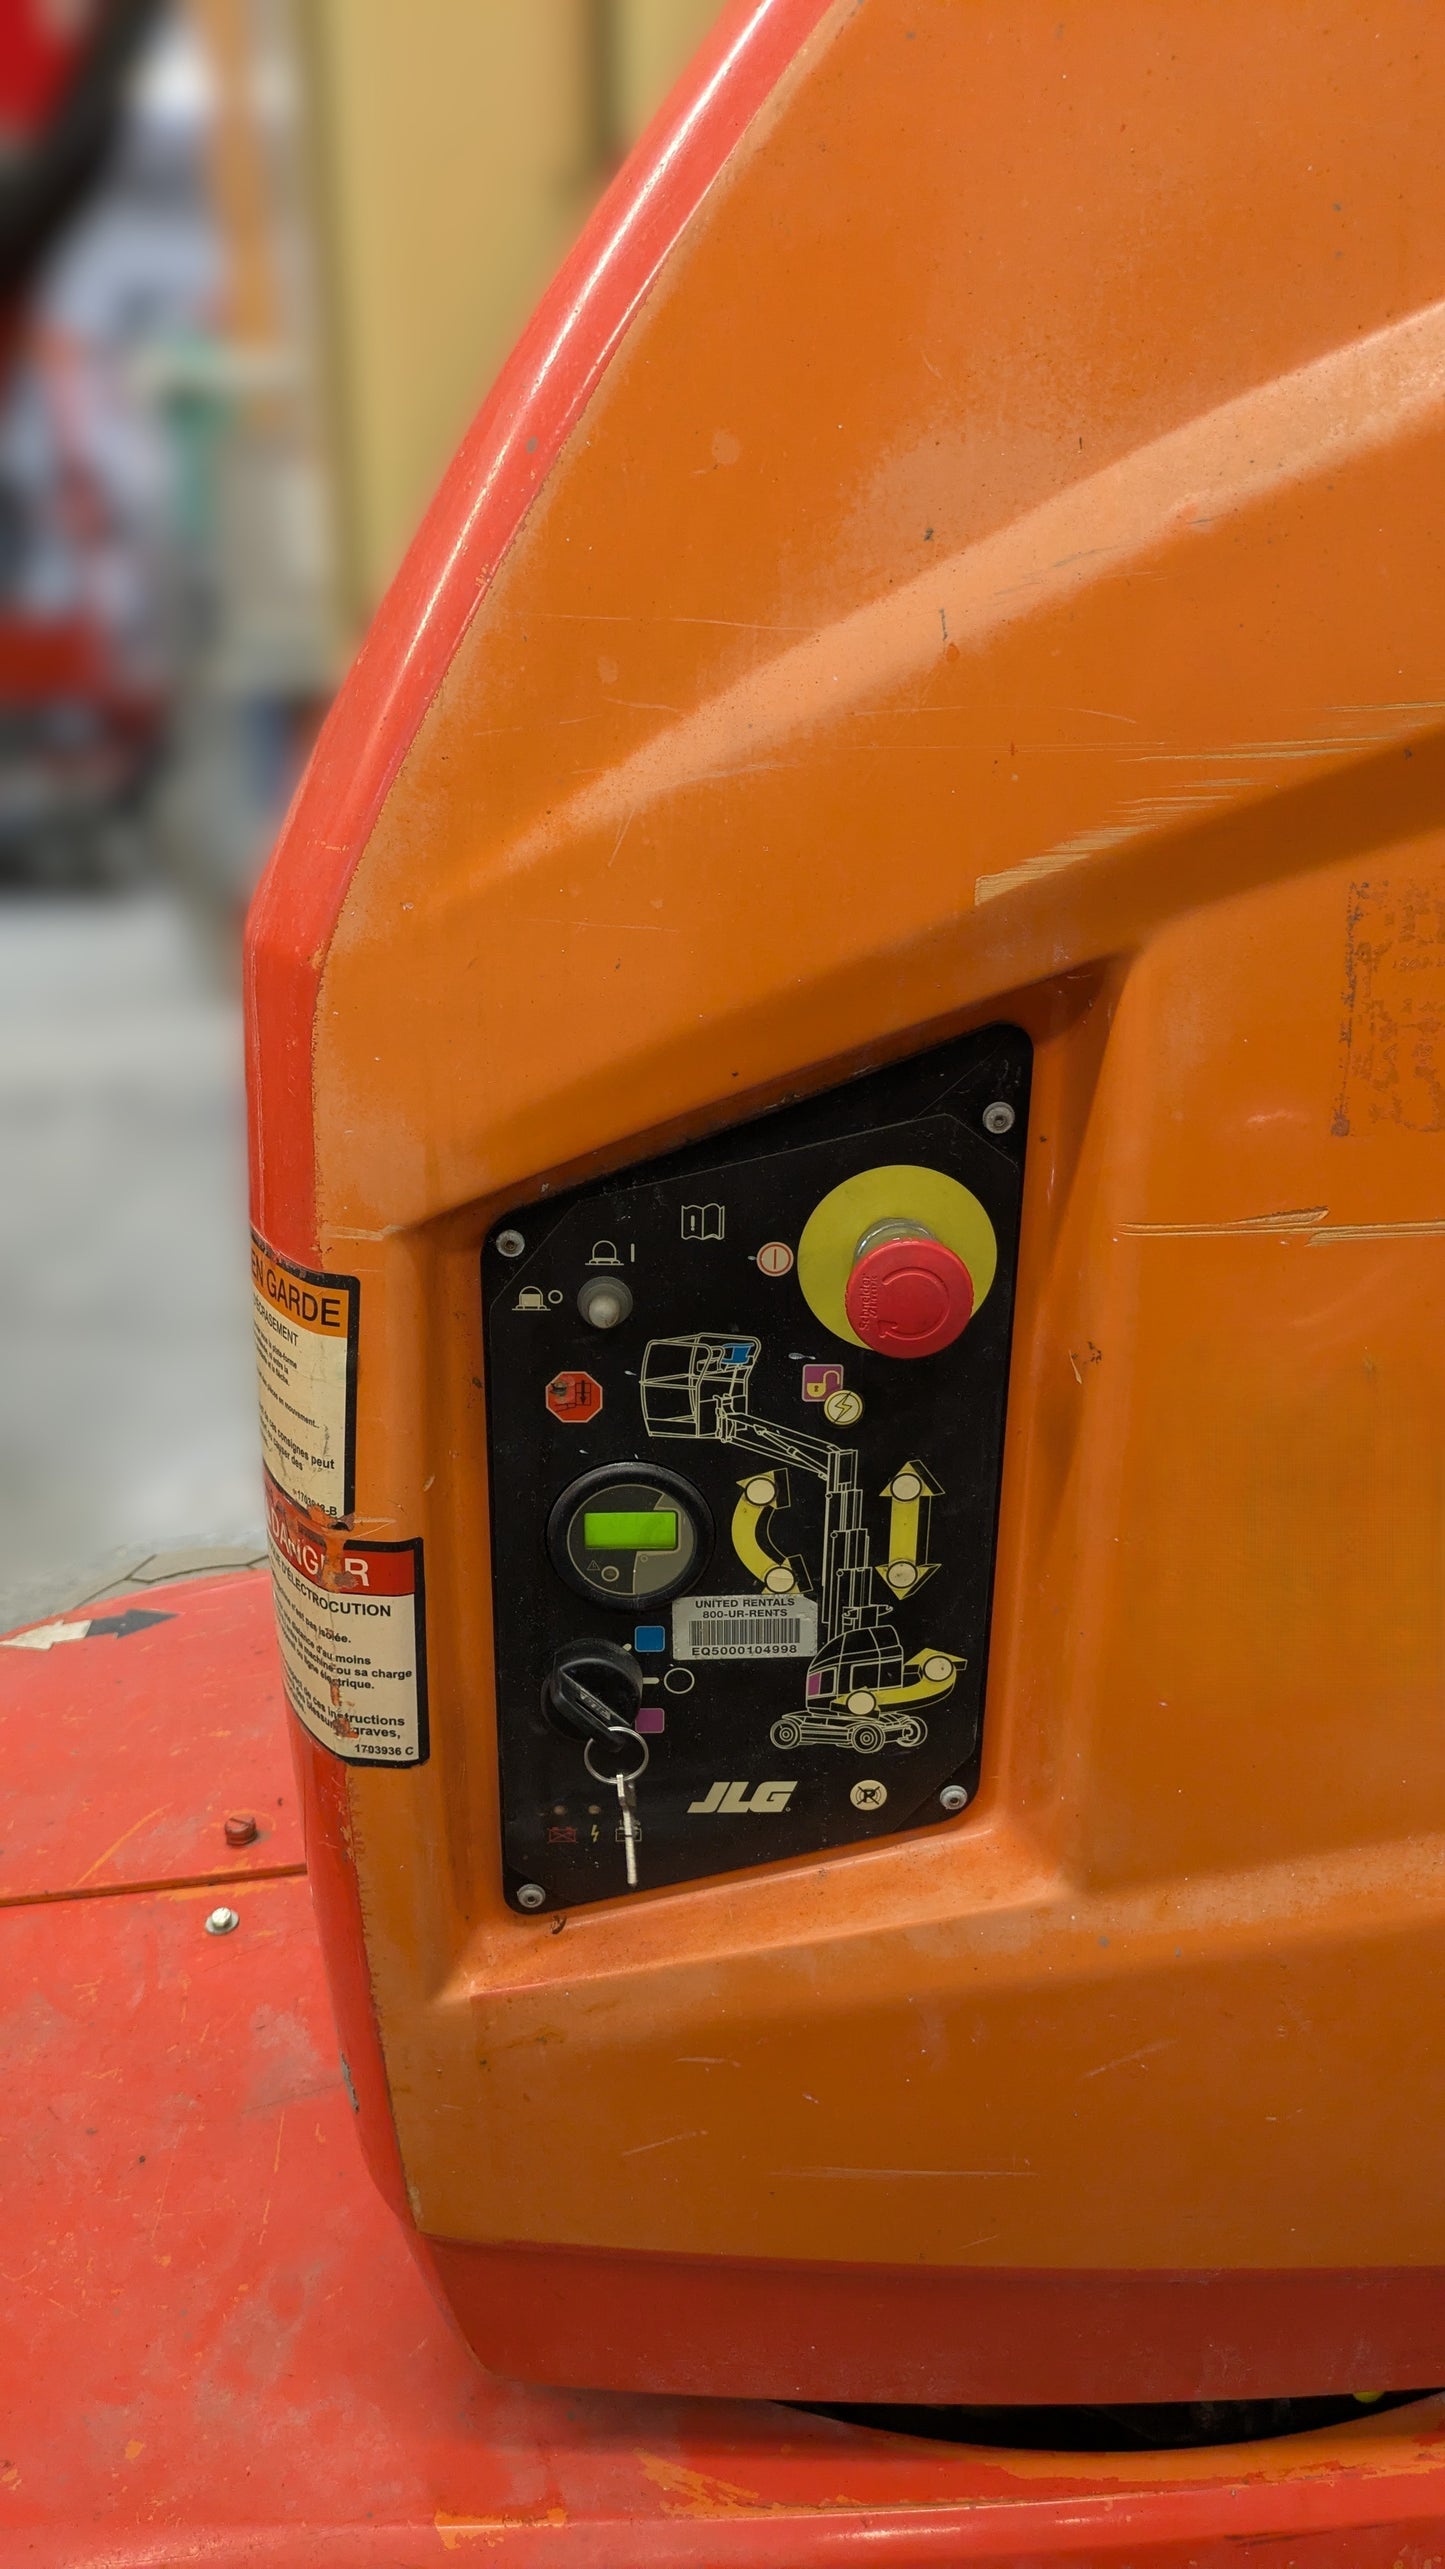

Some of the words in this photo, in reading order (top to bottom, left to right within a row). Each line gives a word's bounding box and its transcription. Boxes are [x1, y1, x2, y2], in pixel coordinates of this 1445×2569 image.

[252, 1255, 264, 1287] EN
[266, 1269, 341, 1327] GARDE
[253, 1294, 299, 1347] ÉCRASEMENT
[277, 1429, 310, 1461] consignes
[310, 1455, 335, 1470] peut
[291, 1455, 303, 1471] des
[270, 1507, 370, 1587] DANGR
[695, 1599, 739, 1608] UNITED
[743, 1598, 795, 1607] RENTALS
[702, 1608, 788, 1619] 800-UR-RENTS
[691, 1645, 798, 1657] EQ5000104998
[303, 1646, 335, 1673] machine
[336, 1667, 351, 1675] ou
[354, 1668, 369, 1678] sa
[371, 1668, 413, 1681] charge
[335, 1655, 372, 1665] moins
[312, 1697, 327, 1713] ces
[354, 1744, 402, 1756] 1703936
[404, 1746, 415, 1756] C
[686, 1780, 799, 1814] JLG
